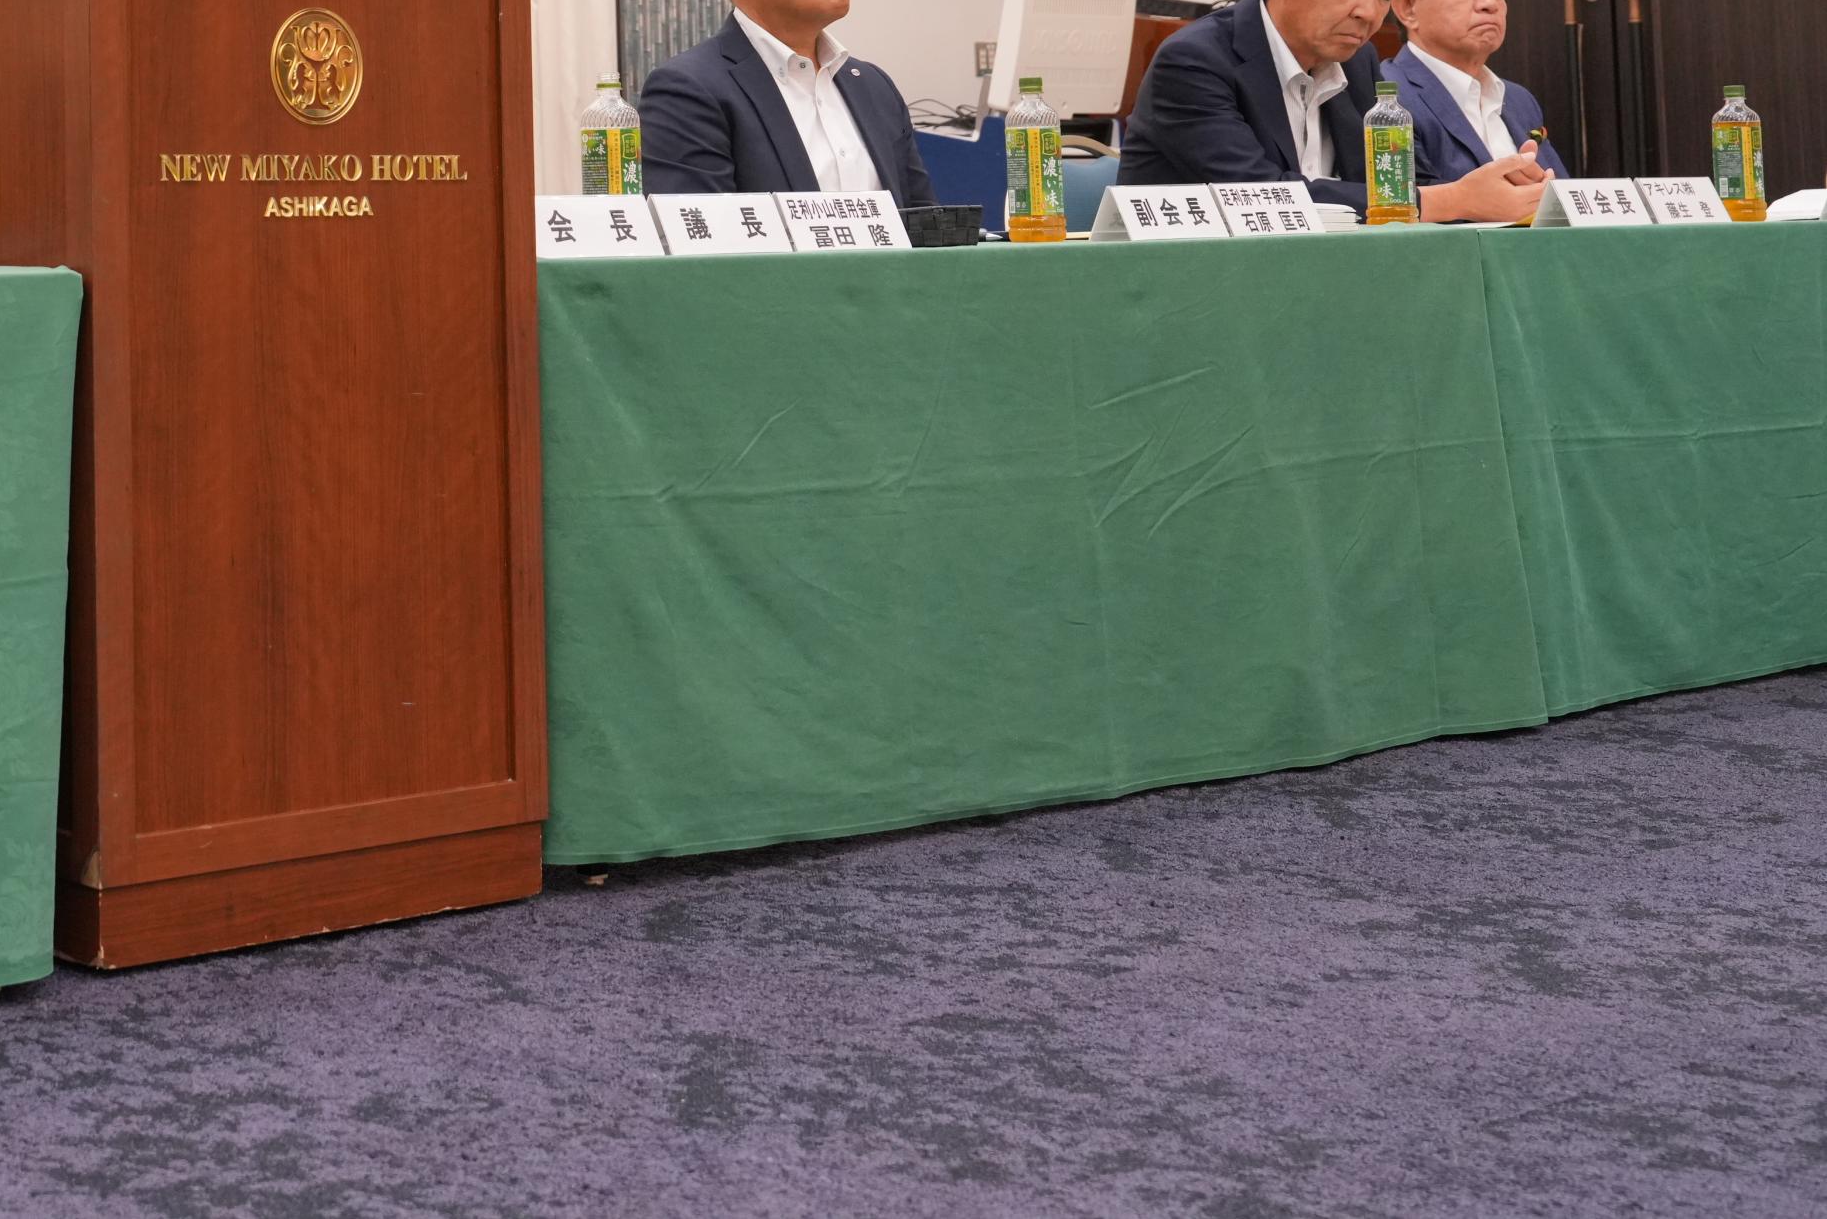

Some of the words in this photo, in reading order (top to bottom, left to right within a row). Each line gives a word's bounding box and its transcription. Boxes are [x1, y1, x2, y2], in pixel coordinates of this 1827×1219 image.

[159, 153, 232, 182] NEW
[240, 153, 363, 182] MIYAKO
[369, 153, 469, 182] HOTEL
[1375, 152, 1396, 199] 濃い味
[1042, 156, 1060, 207] 濃い味
[264, 194, 375, 218] ASHIKAGA
[786, 197, 882, 220] 足利小山信用金庫
[1219, 186, 1295, 206] 足利赤十字病院
[1568, 189, 1637, 216] 副会長
[1130, 197, 1211, 227] 副会長
[1241, 211, 1274, 232] 石原
[1278, 211, 1311, 231] 匡司
[808, 225, 857, 248] 冨田
[867, 223, 894, 247] 隆
